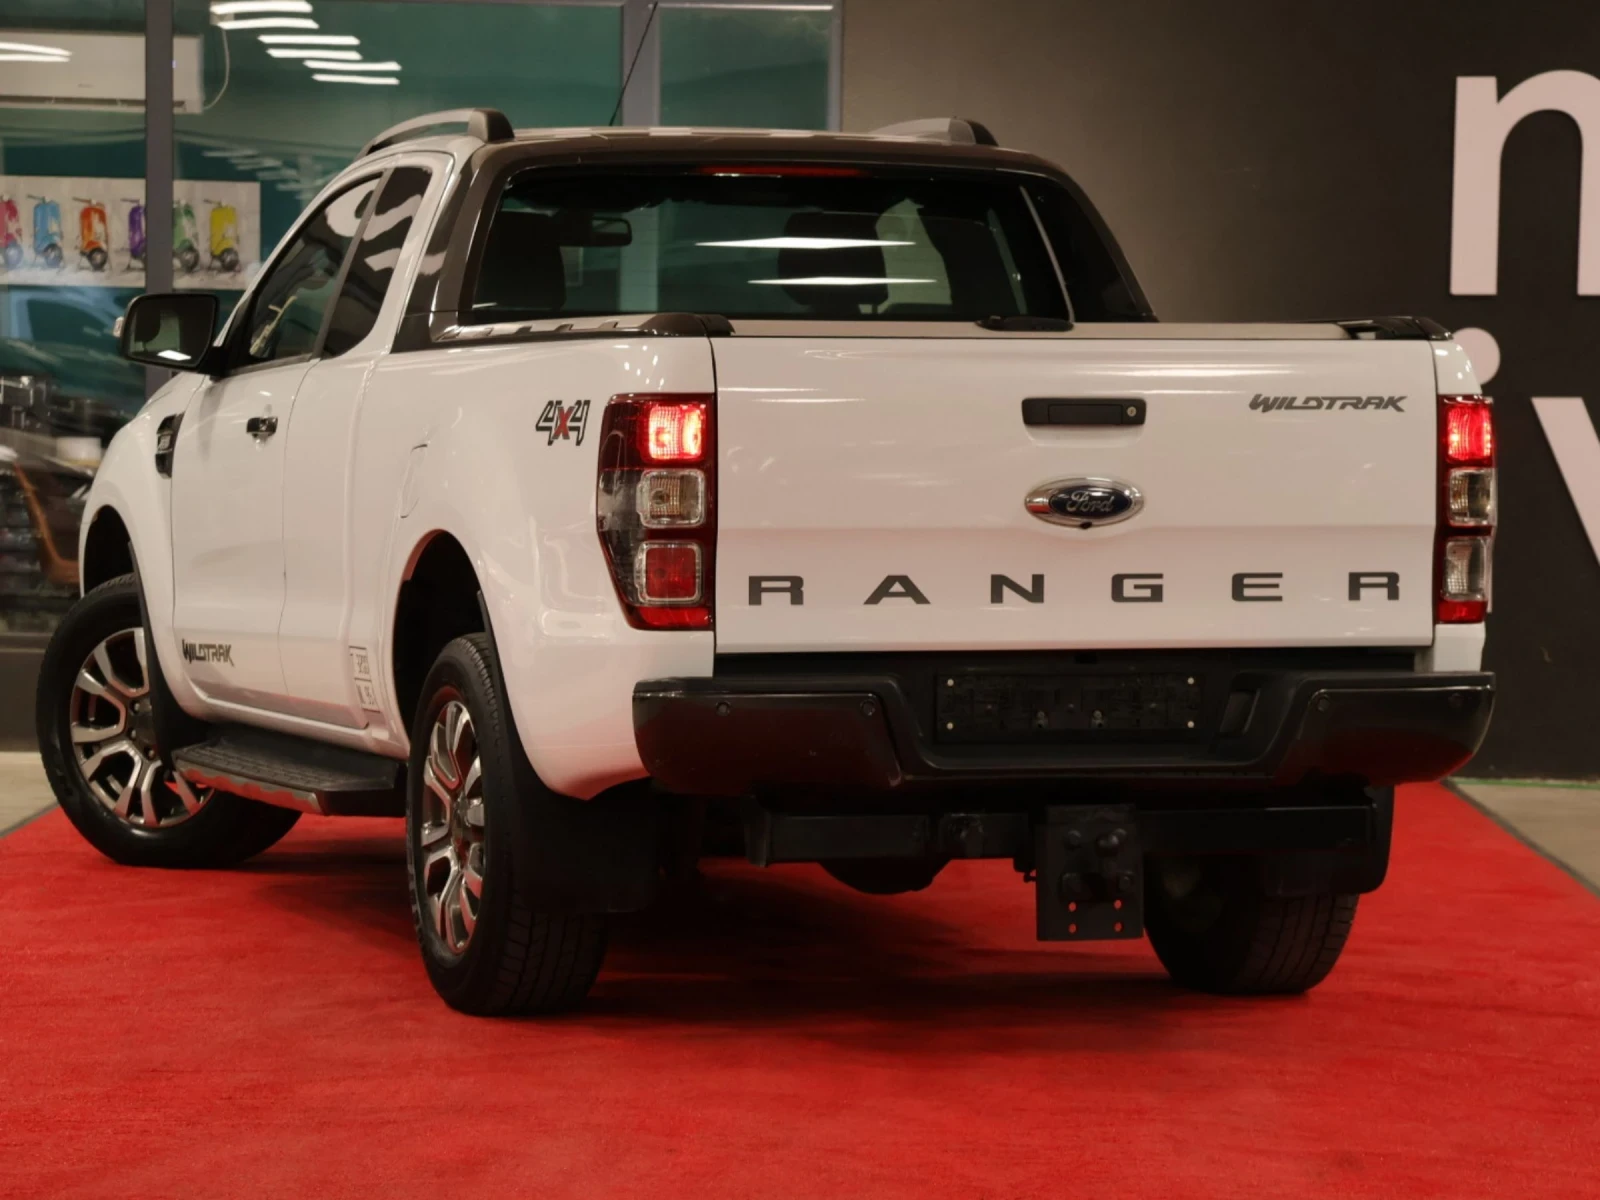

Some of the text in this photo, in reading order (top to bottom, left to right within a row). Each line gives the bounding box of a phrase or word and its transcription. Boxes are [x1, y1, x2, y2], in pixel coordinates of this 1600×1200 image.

[1248, 393, 1408, 414] WILDTRAK
[1065, 490, 1115, 513] Ford
[748, 571, 1400, 606] RANGER
[181, 638, 235, 668] WILDTRAK
